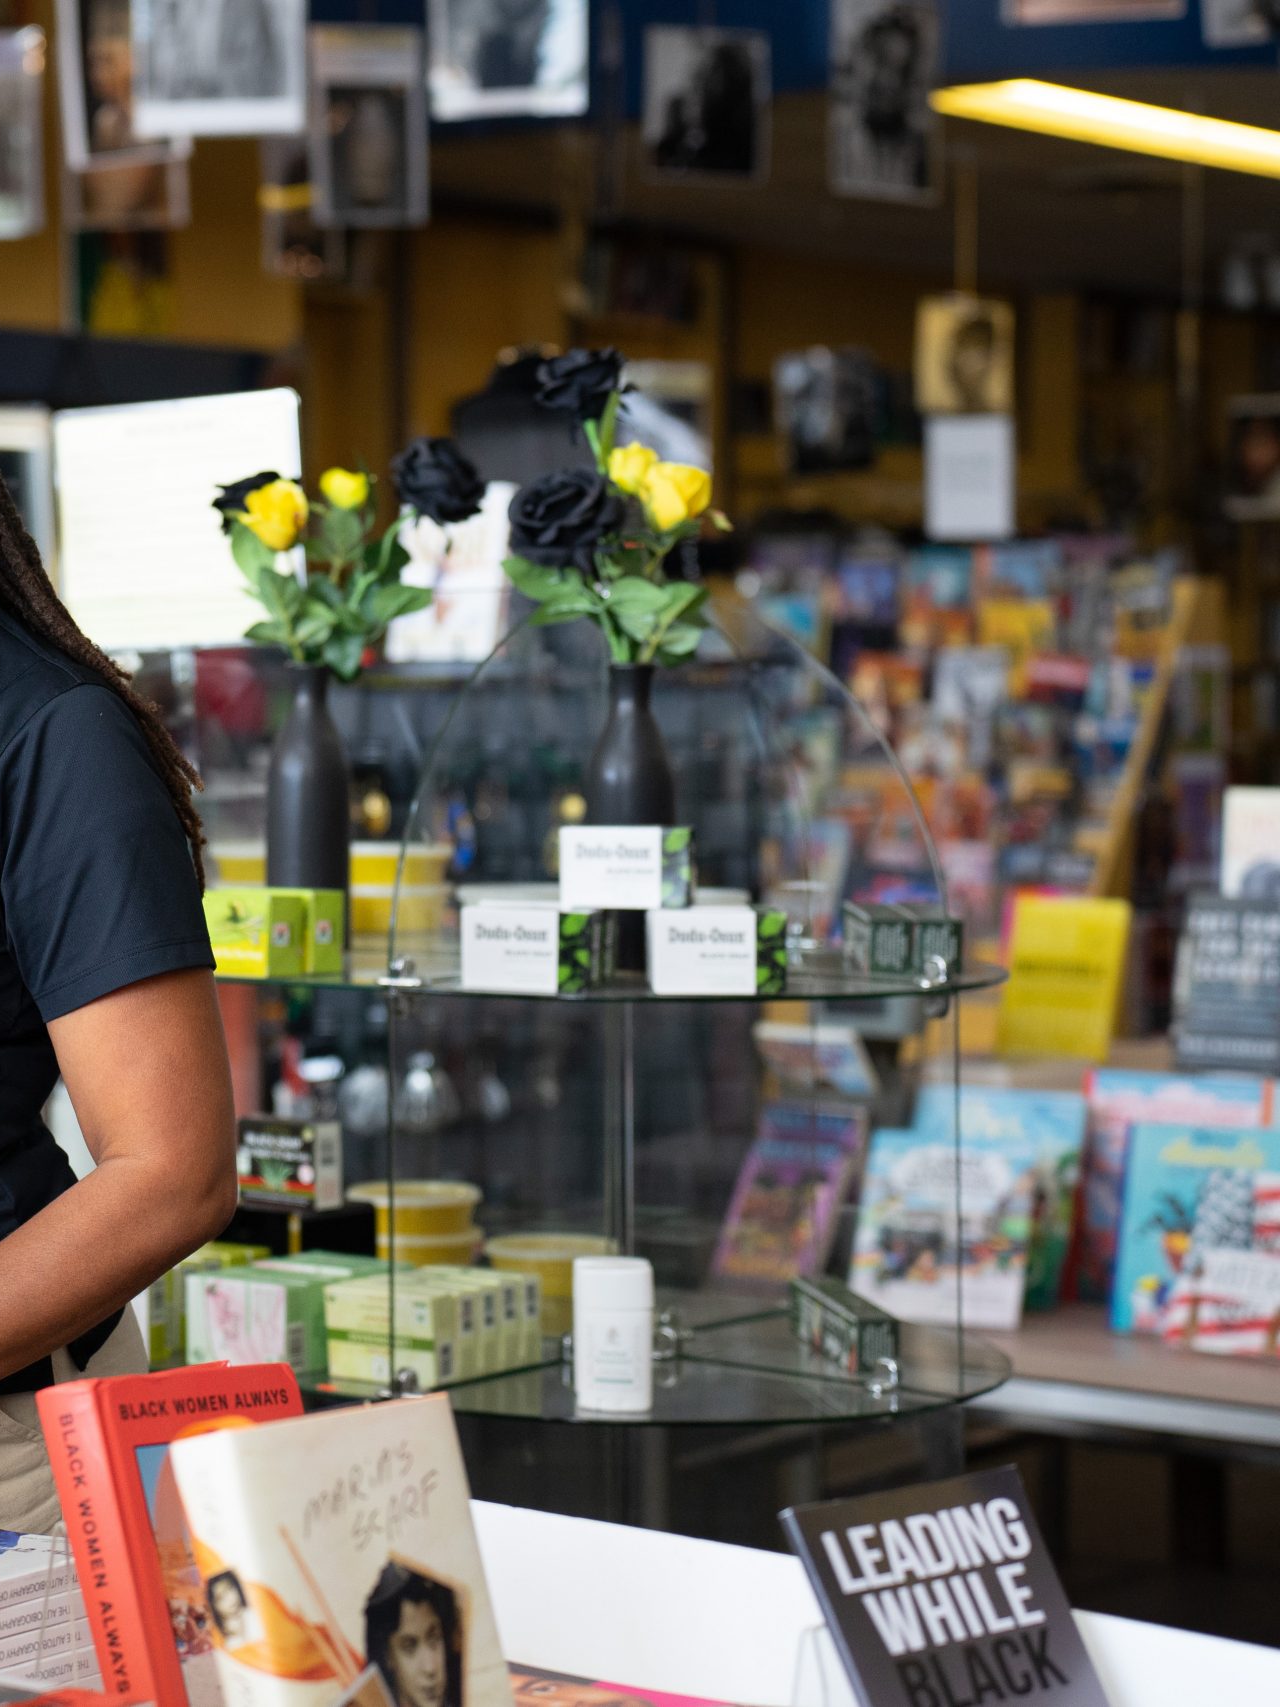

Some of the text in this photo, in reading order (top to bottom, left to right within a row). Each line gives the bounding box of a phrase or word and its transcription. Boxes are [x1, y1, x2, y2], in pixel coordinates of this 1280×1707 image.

[119, 1388, 289, 1420] BLACK WOMEN ALWAYS
[59, 1413, 131, 1694] BLACK WOMEN ALWAYS
[820, 1497, 1032, 1596] LEADING
[861, 1562, 1047, 1656] WHILE
[893, 1627, 1070, 1707] BLACK
